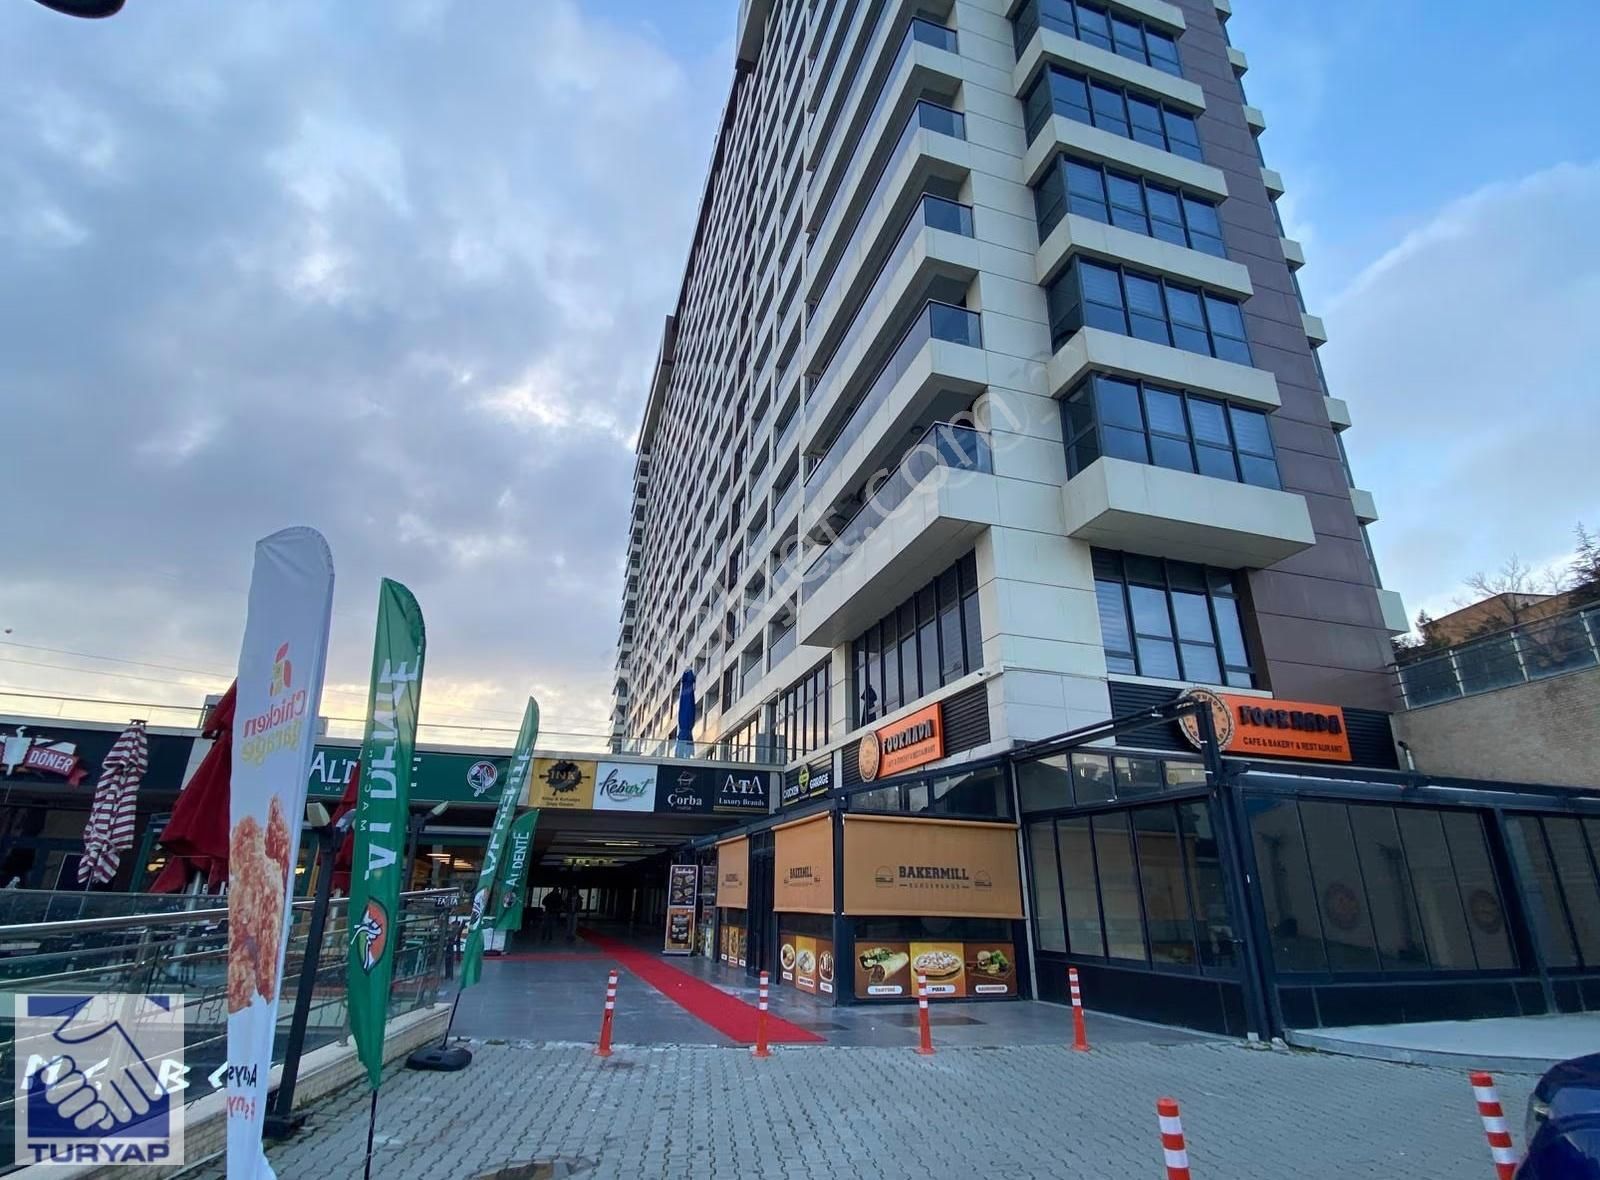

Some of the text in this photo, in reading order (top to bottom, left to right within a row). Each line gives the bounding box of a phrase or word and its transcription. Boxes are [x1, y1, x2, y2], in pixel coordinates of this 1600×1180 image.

[1268, 739, 1294, 749] BAKERY
[1301, 742, 1343, 753] RESTAURANT
[28, 749, 74, 773] DÖNER
[667, 793, 703, 807] Çorba
[719, 797, 765, 807] Luxury Brands
[898, 865, 970, 880] BAKERMILL
